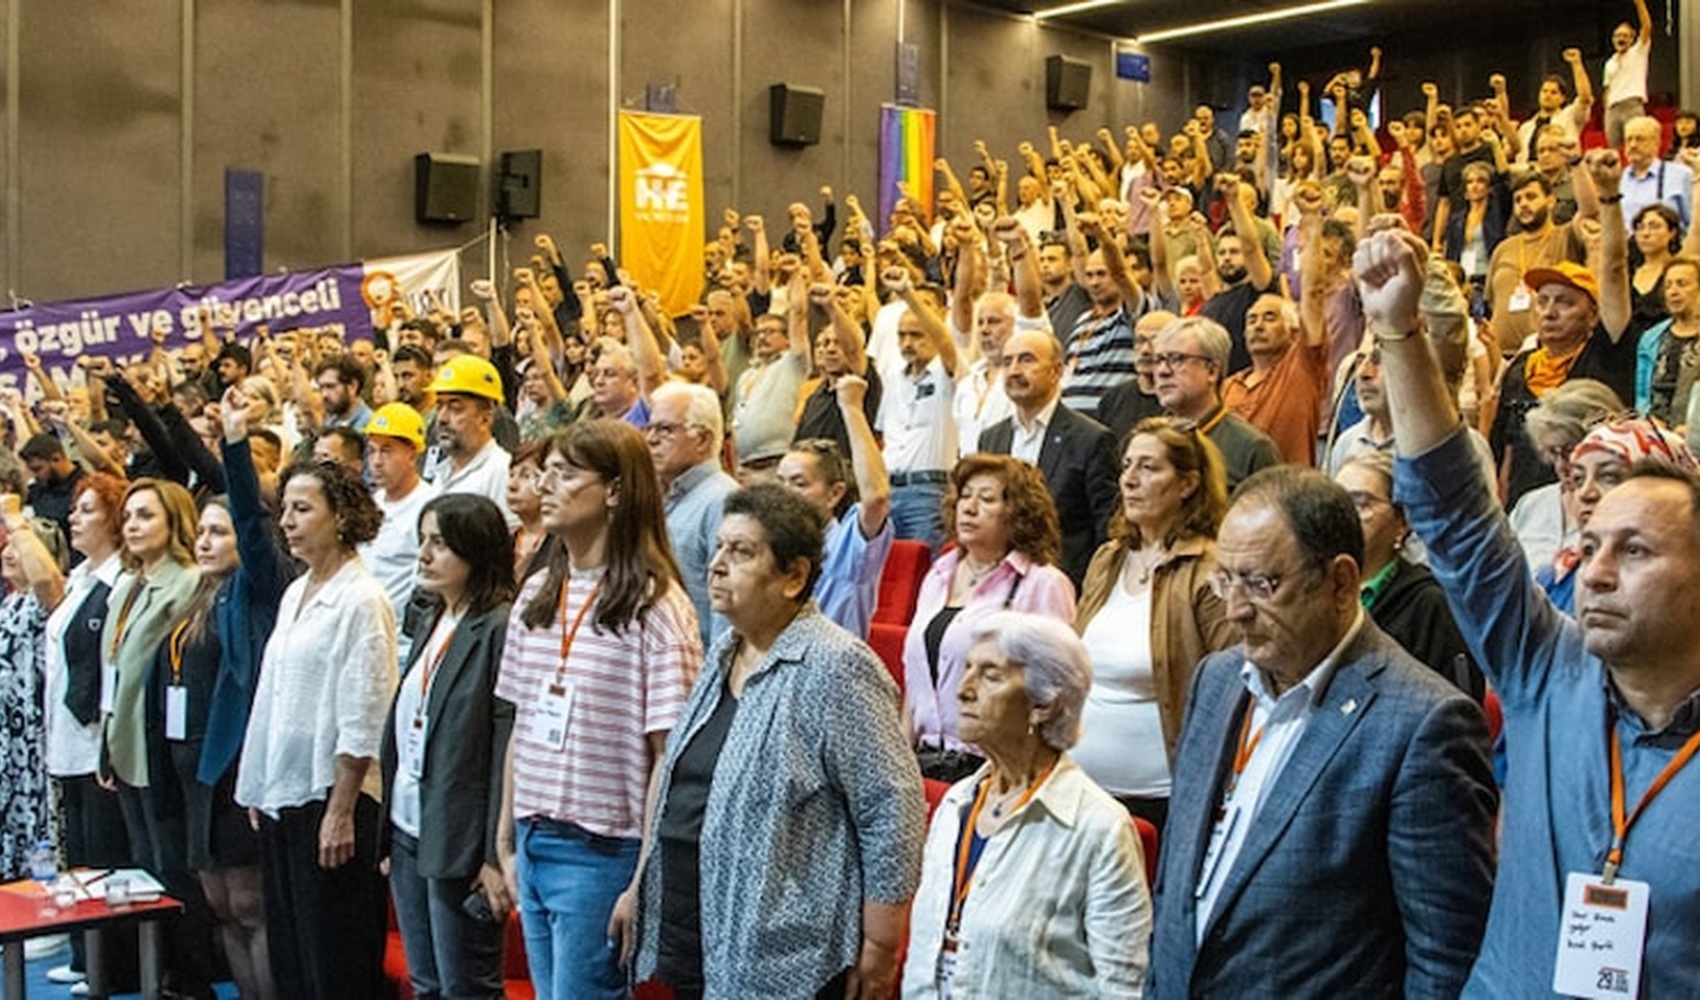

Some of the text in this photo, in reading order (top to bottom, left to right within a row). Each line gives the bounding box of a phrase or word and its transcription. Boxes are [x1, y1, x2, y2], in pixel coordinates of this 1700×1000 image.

[14, 310, 121, 356] özgür
[128, 309, 174, 337] ve
[180, 277, 341, 339] güvenceli
